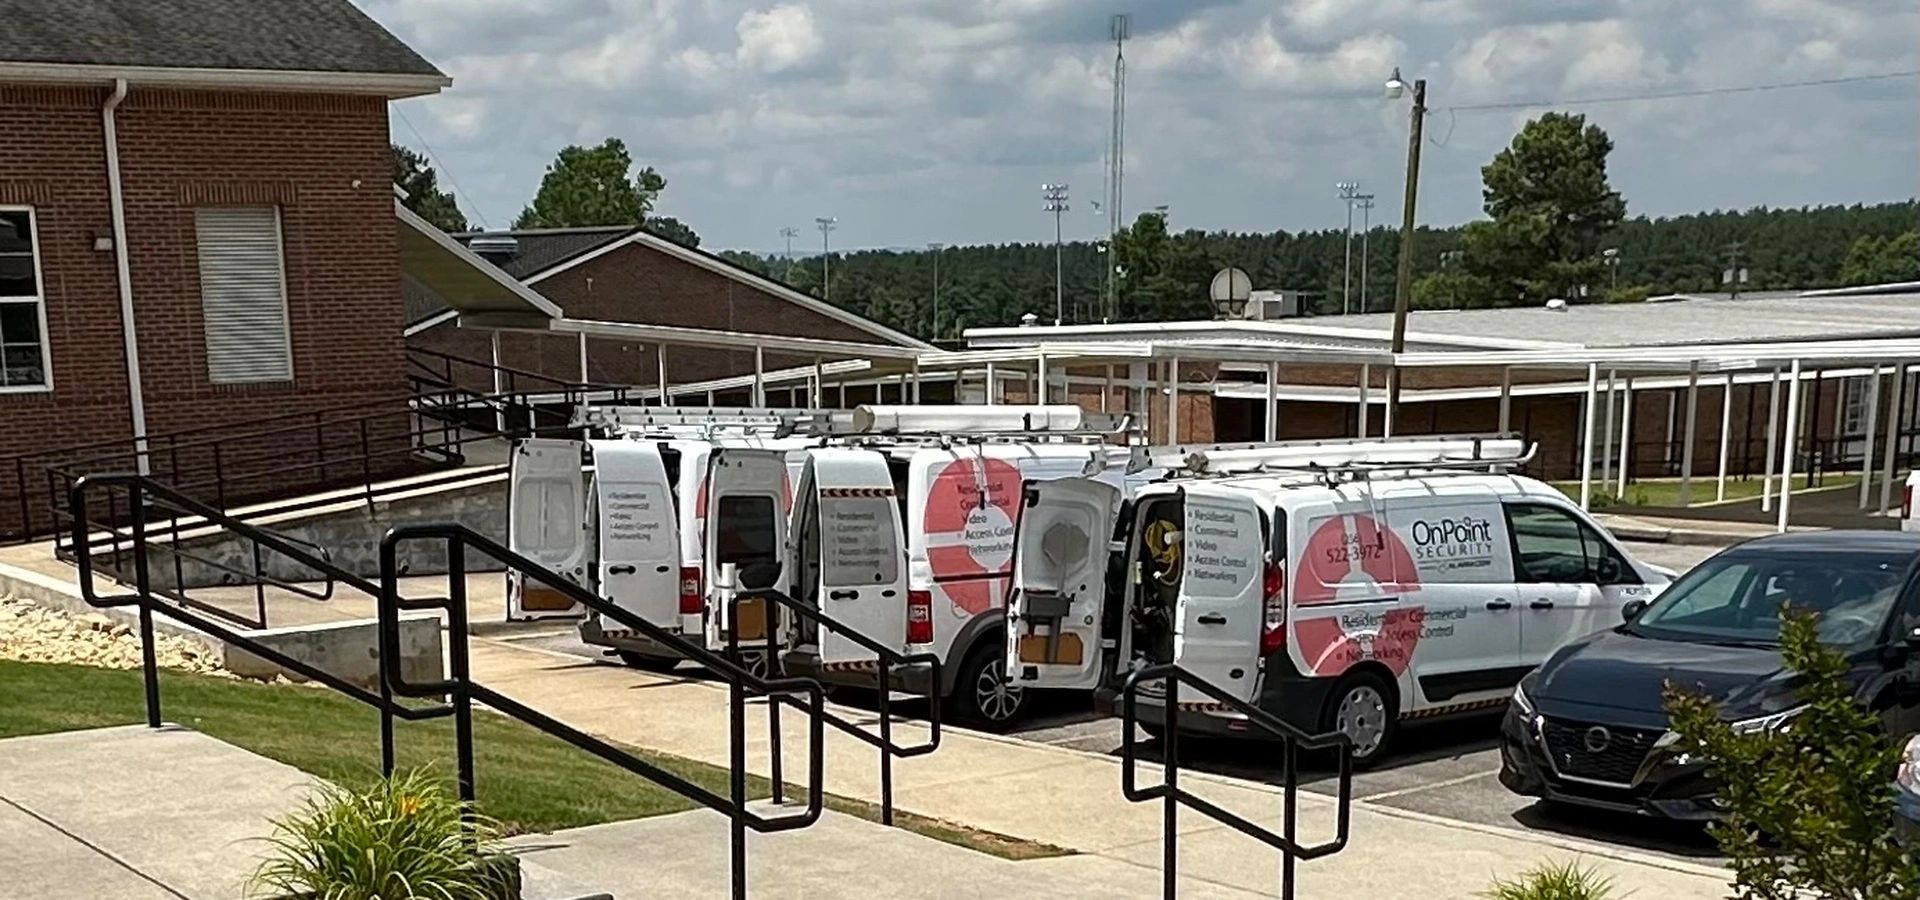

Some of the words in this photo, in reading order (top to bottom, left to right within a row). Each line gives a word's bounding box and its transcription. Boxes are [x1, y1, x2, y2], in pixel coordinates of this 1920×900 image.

[1194, 510, 1236, 523] Residential
[965, 529, 994, 540] Access
[1195, 524, 1239, 538] Commercial
[1412, 516, 1492, 546] OnPoint
[968, 542, 1012, 554] etworkin
[1194, 540, 1218, 551] Video
[1416, 542, 1492, 559] SECURITY
[1326, 543, 1381, 564] 522-3972
[1194, 554, 1220, 566] Access
[1220, 555, 1247, 568] Control
[1194, 568, 1238, 584] Networking
[1409, 605, 1468, 623] Commercial
[1418, 624, 1454, 639] Control
